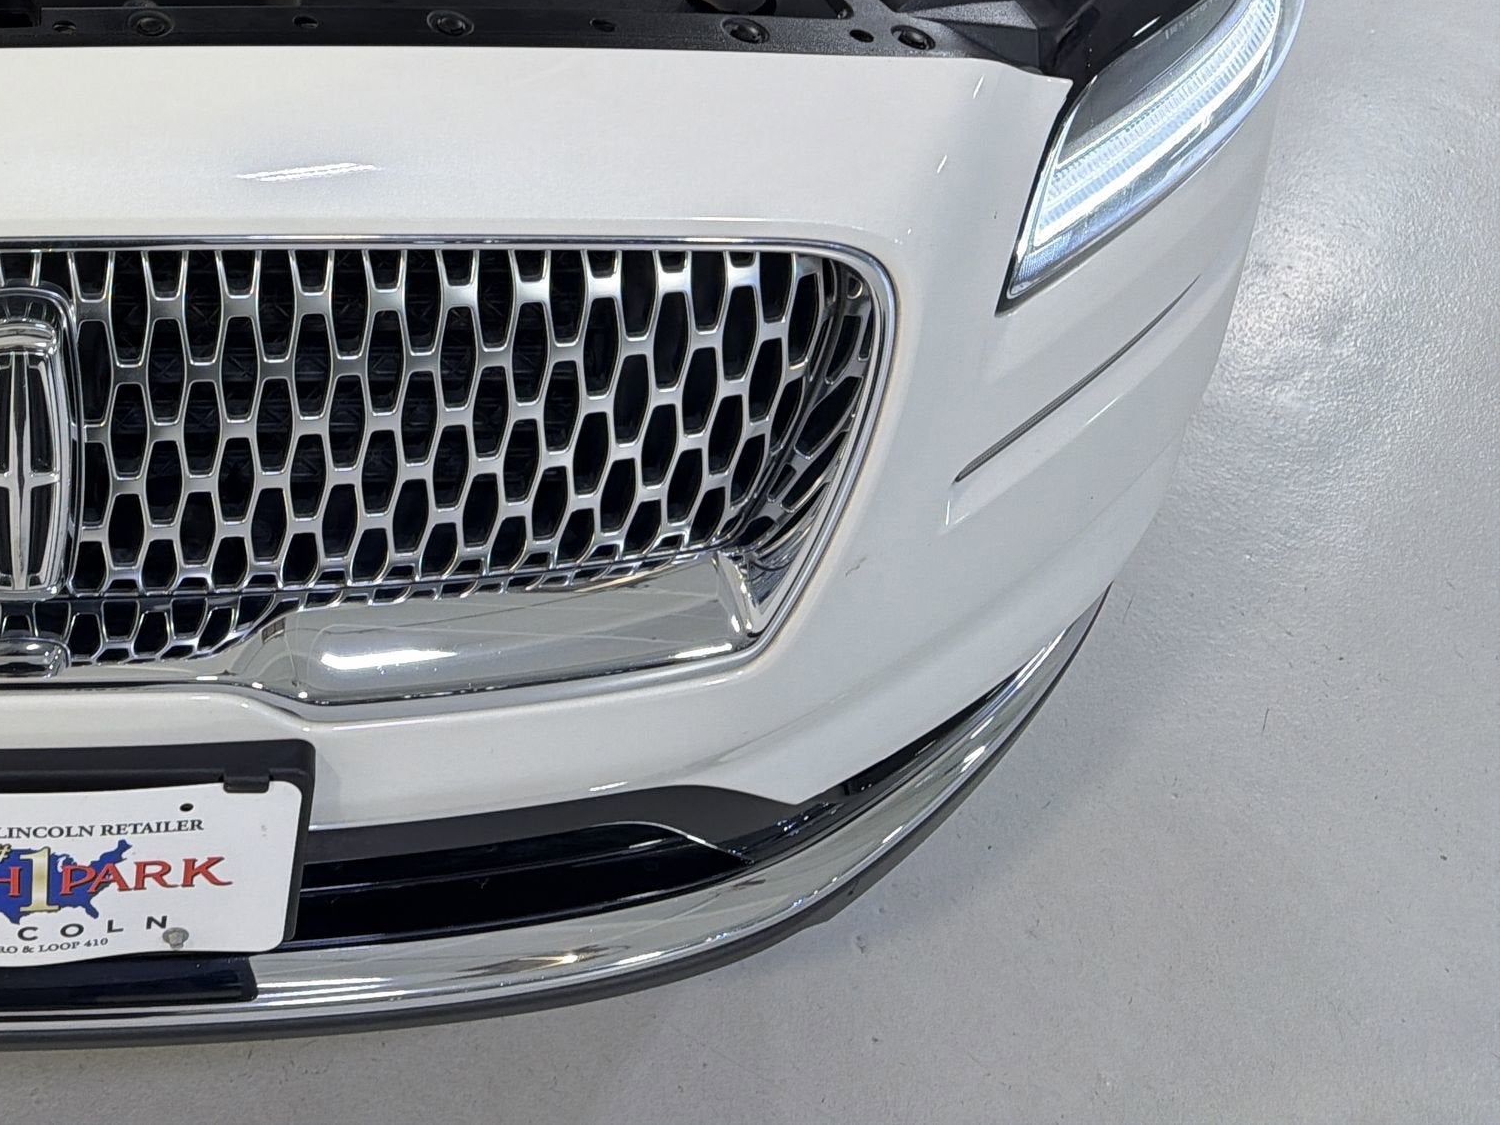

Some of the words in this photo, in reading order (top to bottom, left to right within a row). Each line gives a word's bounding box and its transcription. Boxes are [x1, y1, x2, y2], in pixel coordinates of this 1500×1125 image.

[100, 819, 204, 836] RETAILER
[59, 856, 233, 896] PARK
[22, 945, 34, 954] &
[39, 941, 80, 952] LOOP
[84, 938, 108, 947] 410
